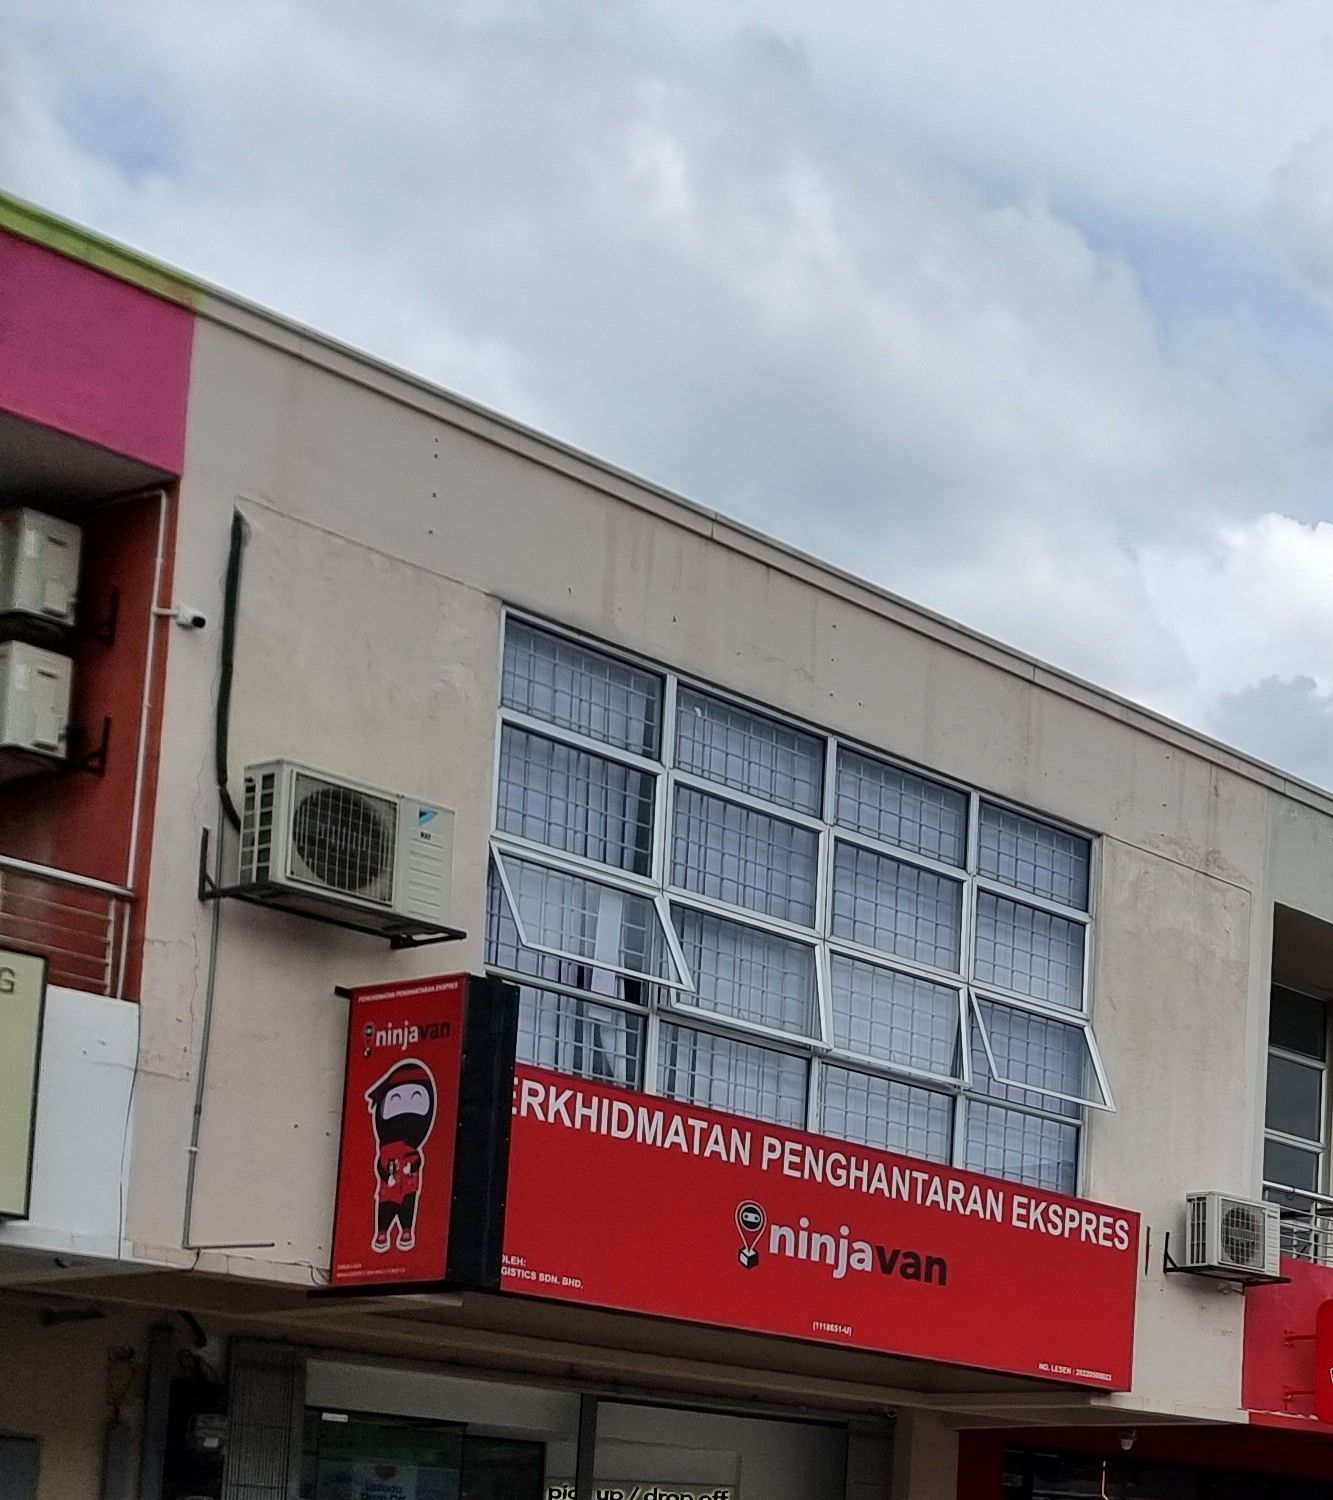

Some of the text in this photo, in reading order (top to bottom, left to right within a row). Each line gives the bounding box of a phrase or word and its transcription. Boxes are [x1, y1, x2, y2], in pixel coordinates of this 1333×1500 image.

[375, 1019, 451, 1051] ninjavan
[761, 1135, 1004, 1223] PENGHANTARAN
[1012, 1195, 1130, 1251] EKSPRES
[769, 1217, 948, 1286] ninjavan
[562, 1277, 584, 1289] BHD.
